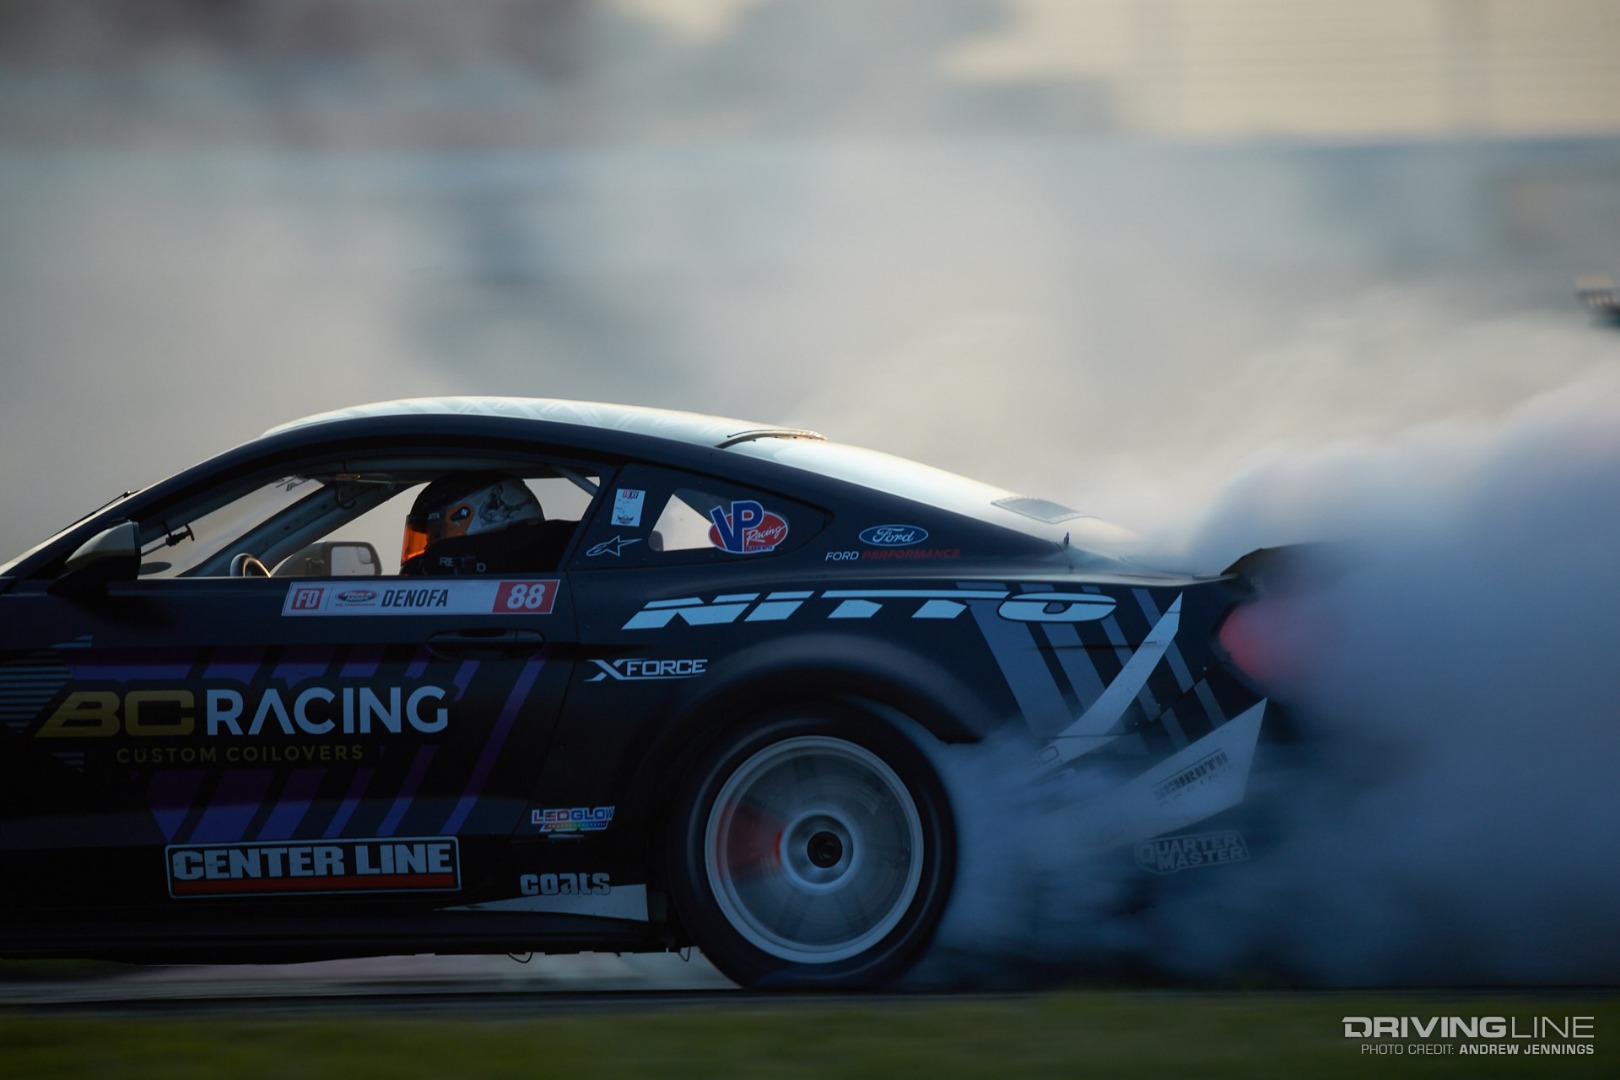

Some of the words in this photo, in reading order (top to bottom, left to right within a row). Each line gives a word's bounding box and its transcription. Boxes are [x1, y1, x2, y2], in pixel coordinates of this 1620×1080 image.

[710, 500, 764, 553] VP
[746, 525, 784, 546] Racing
[872, 527, 915, 543] Ford
[825, 550, 860, 561] FORD
[861, 548, 961, 560] PERFORMANCE
[294, 588, 324, 609] FD
[381, 588, 449, 608] DENOFA
[506, 583, 546, 610] 88
[621, 589, 1118, 630] NITTO
[34, 689, 196, 738] BC
[206, 684, 449, 737] RACING
[116, 746, 218, 765] CUSTOM
[225, 743, 364, 763] COILOVERS
[532, 805, 615, 824] LEDGLOW
[171, 845, 346, 881] CENTER
[354, 843, 453, 876] LINE
[1138, 834, 1240, 864] QUARTER
[1156, 845, 1244, 871] MASTER
